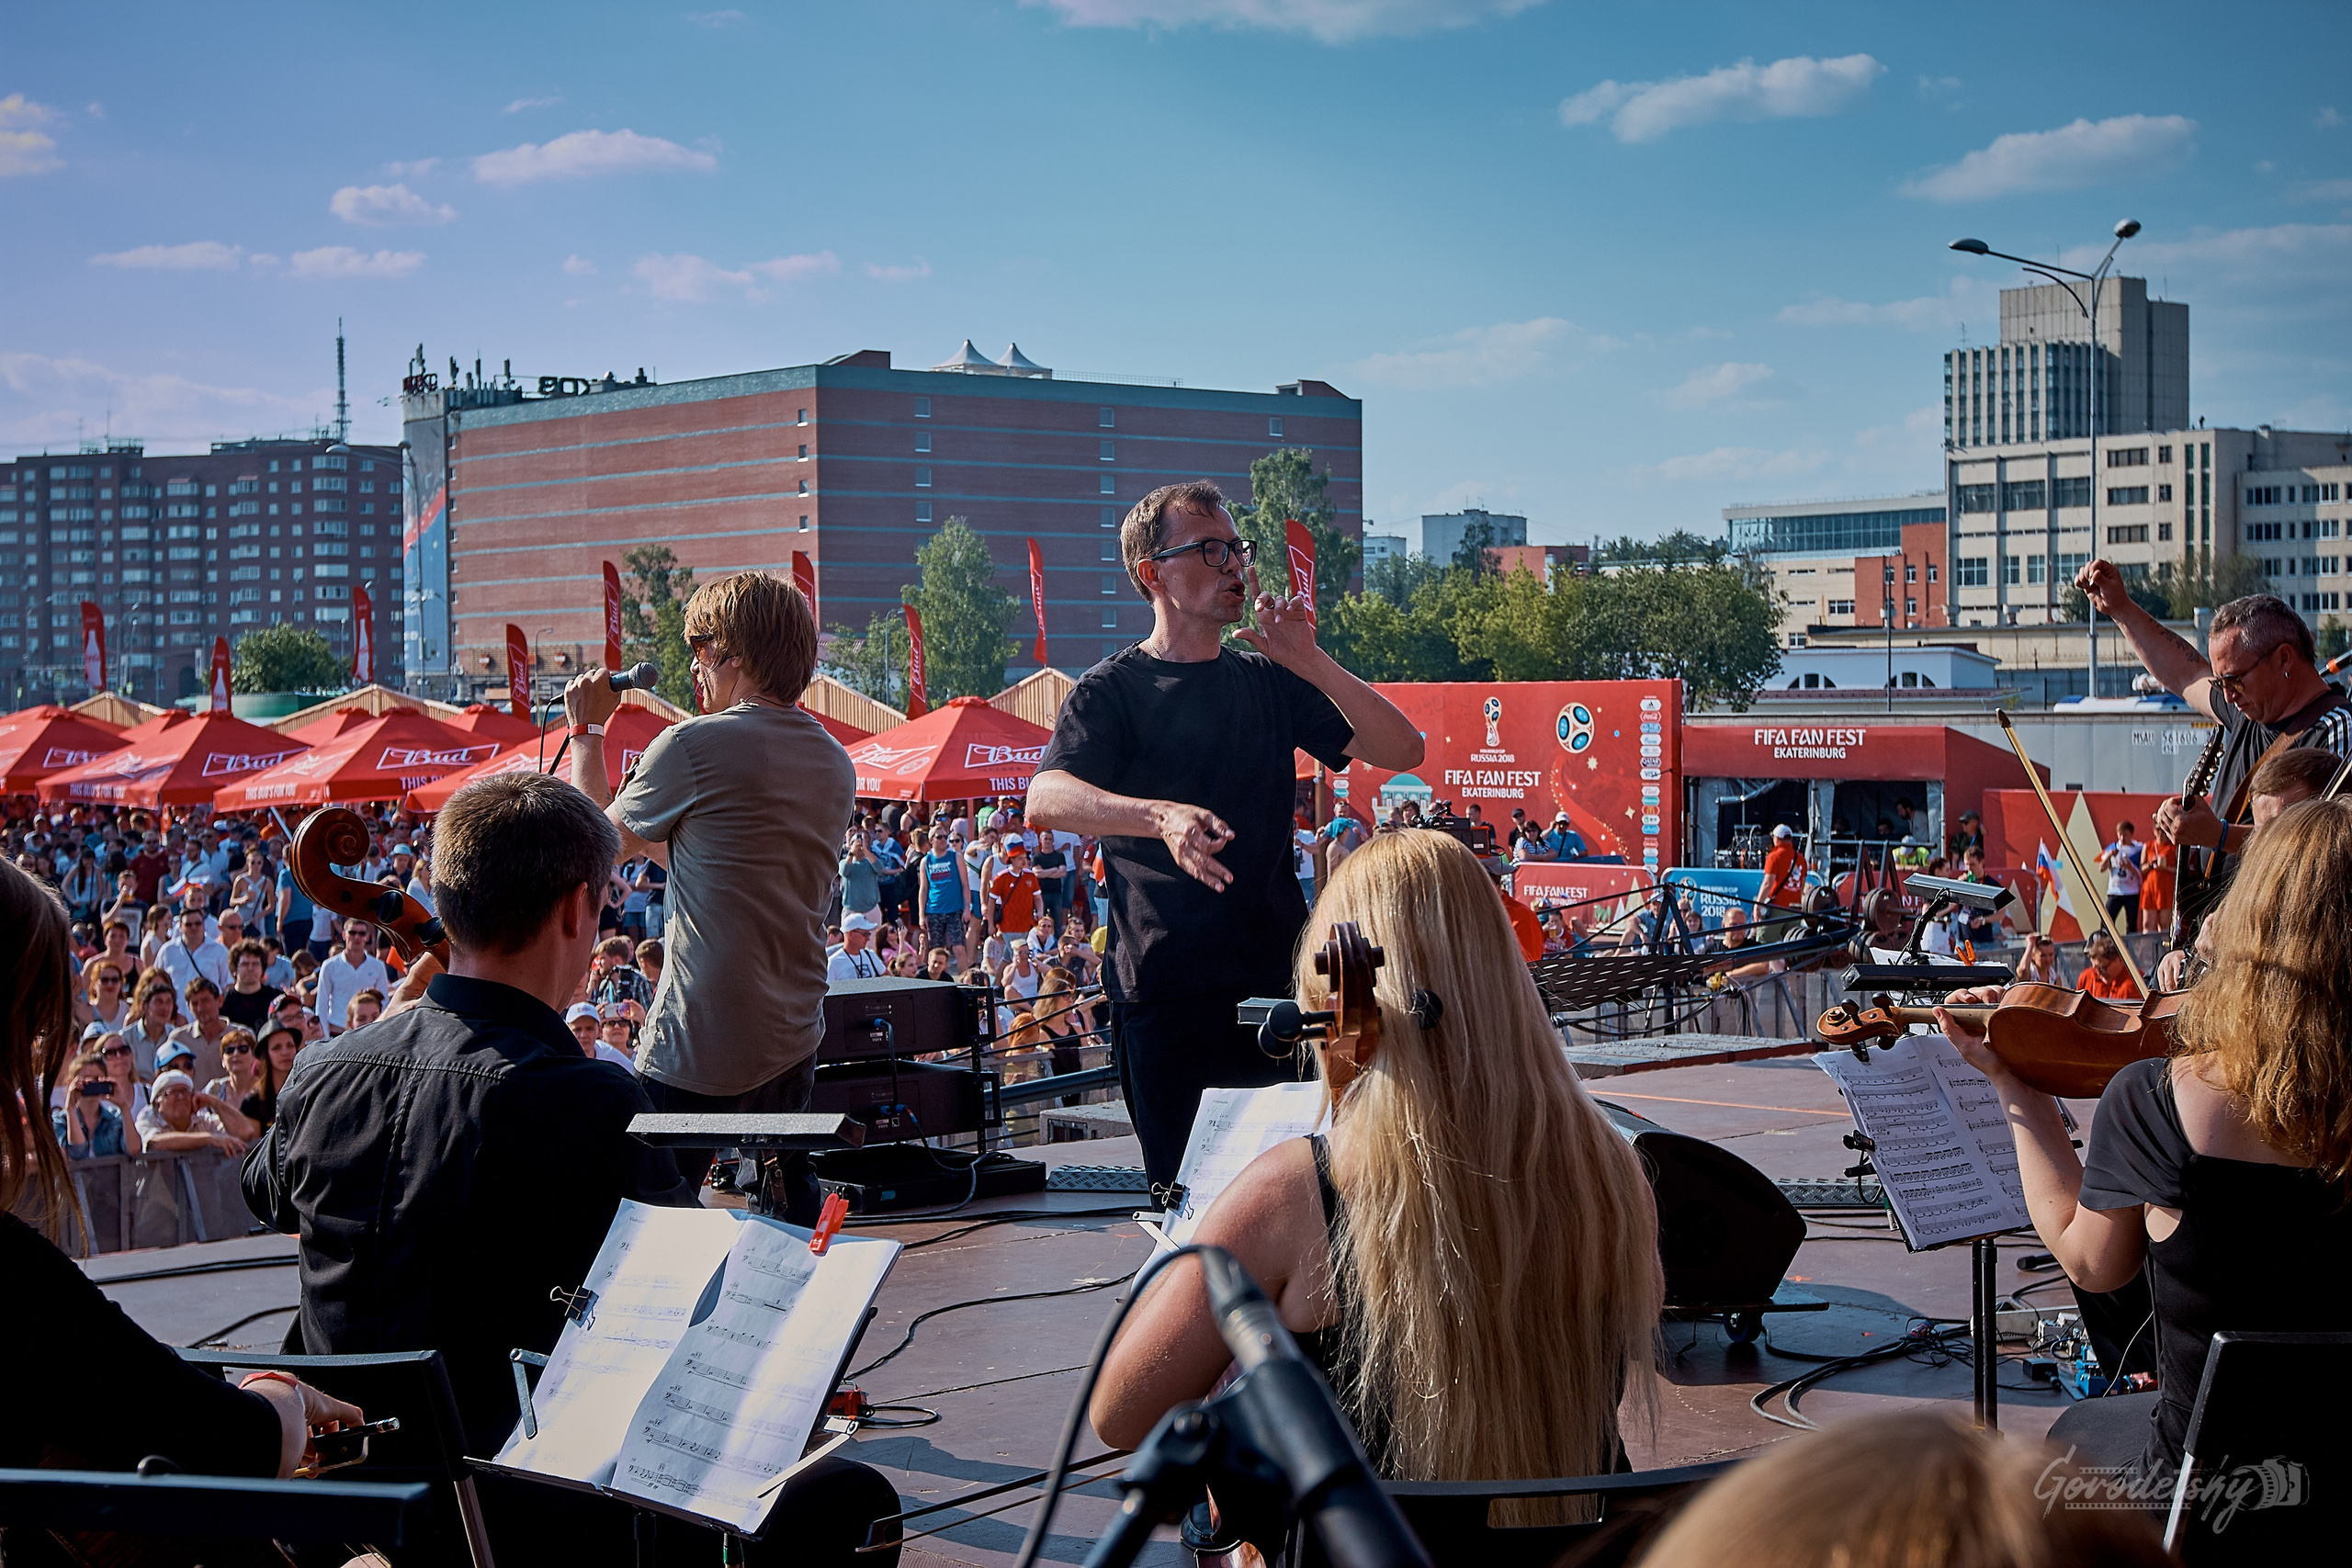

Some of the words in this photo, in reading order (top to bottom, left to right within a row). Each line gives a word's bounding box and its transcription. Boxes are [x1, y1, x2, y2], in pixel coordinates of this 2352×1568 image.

[609, 598, 619, 636] Bud
[912, 647, 921, 686] Bud
[514, 660, 526, 695] Bud
[1754, 728, 1788, 745] FIFA
[1791, 728, 1824, 745] FAN
[1826, 728, 1867, 746] FEST
[391, 749, 472, 765] Bud
[974, 744, 1046, 762] Bud
[1470, 753, 1498, 762] RUSSIA
[1498, 754, 1515, 763] 2018
[1774, 747, 1846, 759] EKATERINBURG
[214, 752, 285, 772] Bud
[400, 775, 427, 790] THIS
[989, 777, 1015, 791] THIS
[1444, 769, 1474, 785] FIFA
[1476, 770, 1505, 785] FAN
[1507, 771, 1542, 787] FEST
[1462, 787, 1524, 799] EKATERINBURG
[1523, 885, 1544, 897] FIFA
[1544, 885, 1564, 897] FAN
[1566, 886, 1589, 898] FEST
[1700, 893, 1741, 906] RUSSIA
[1701, 905, 1725, 918] 2018
